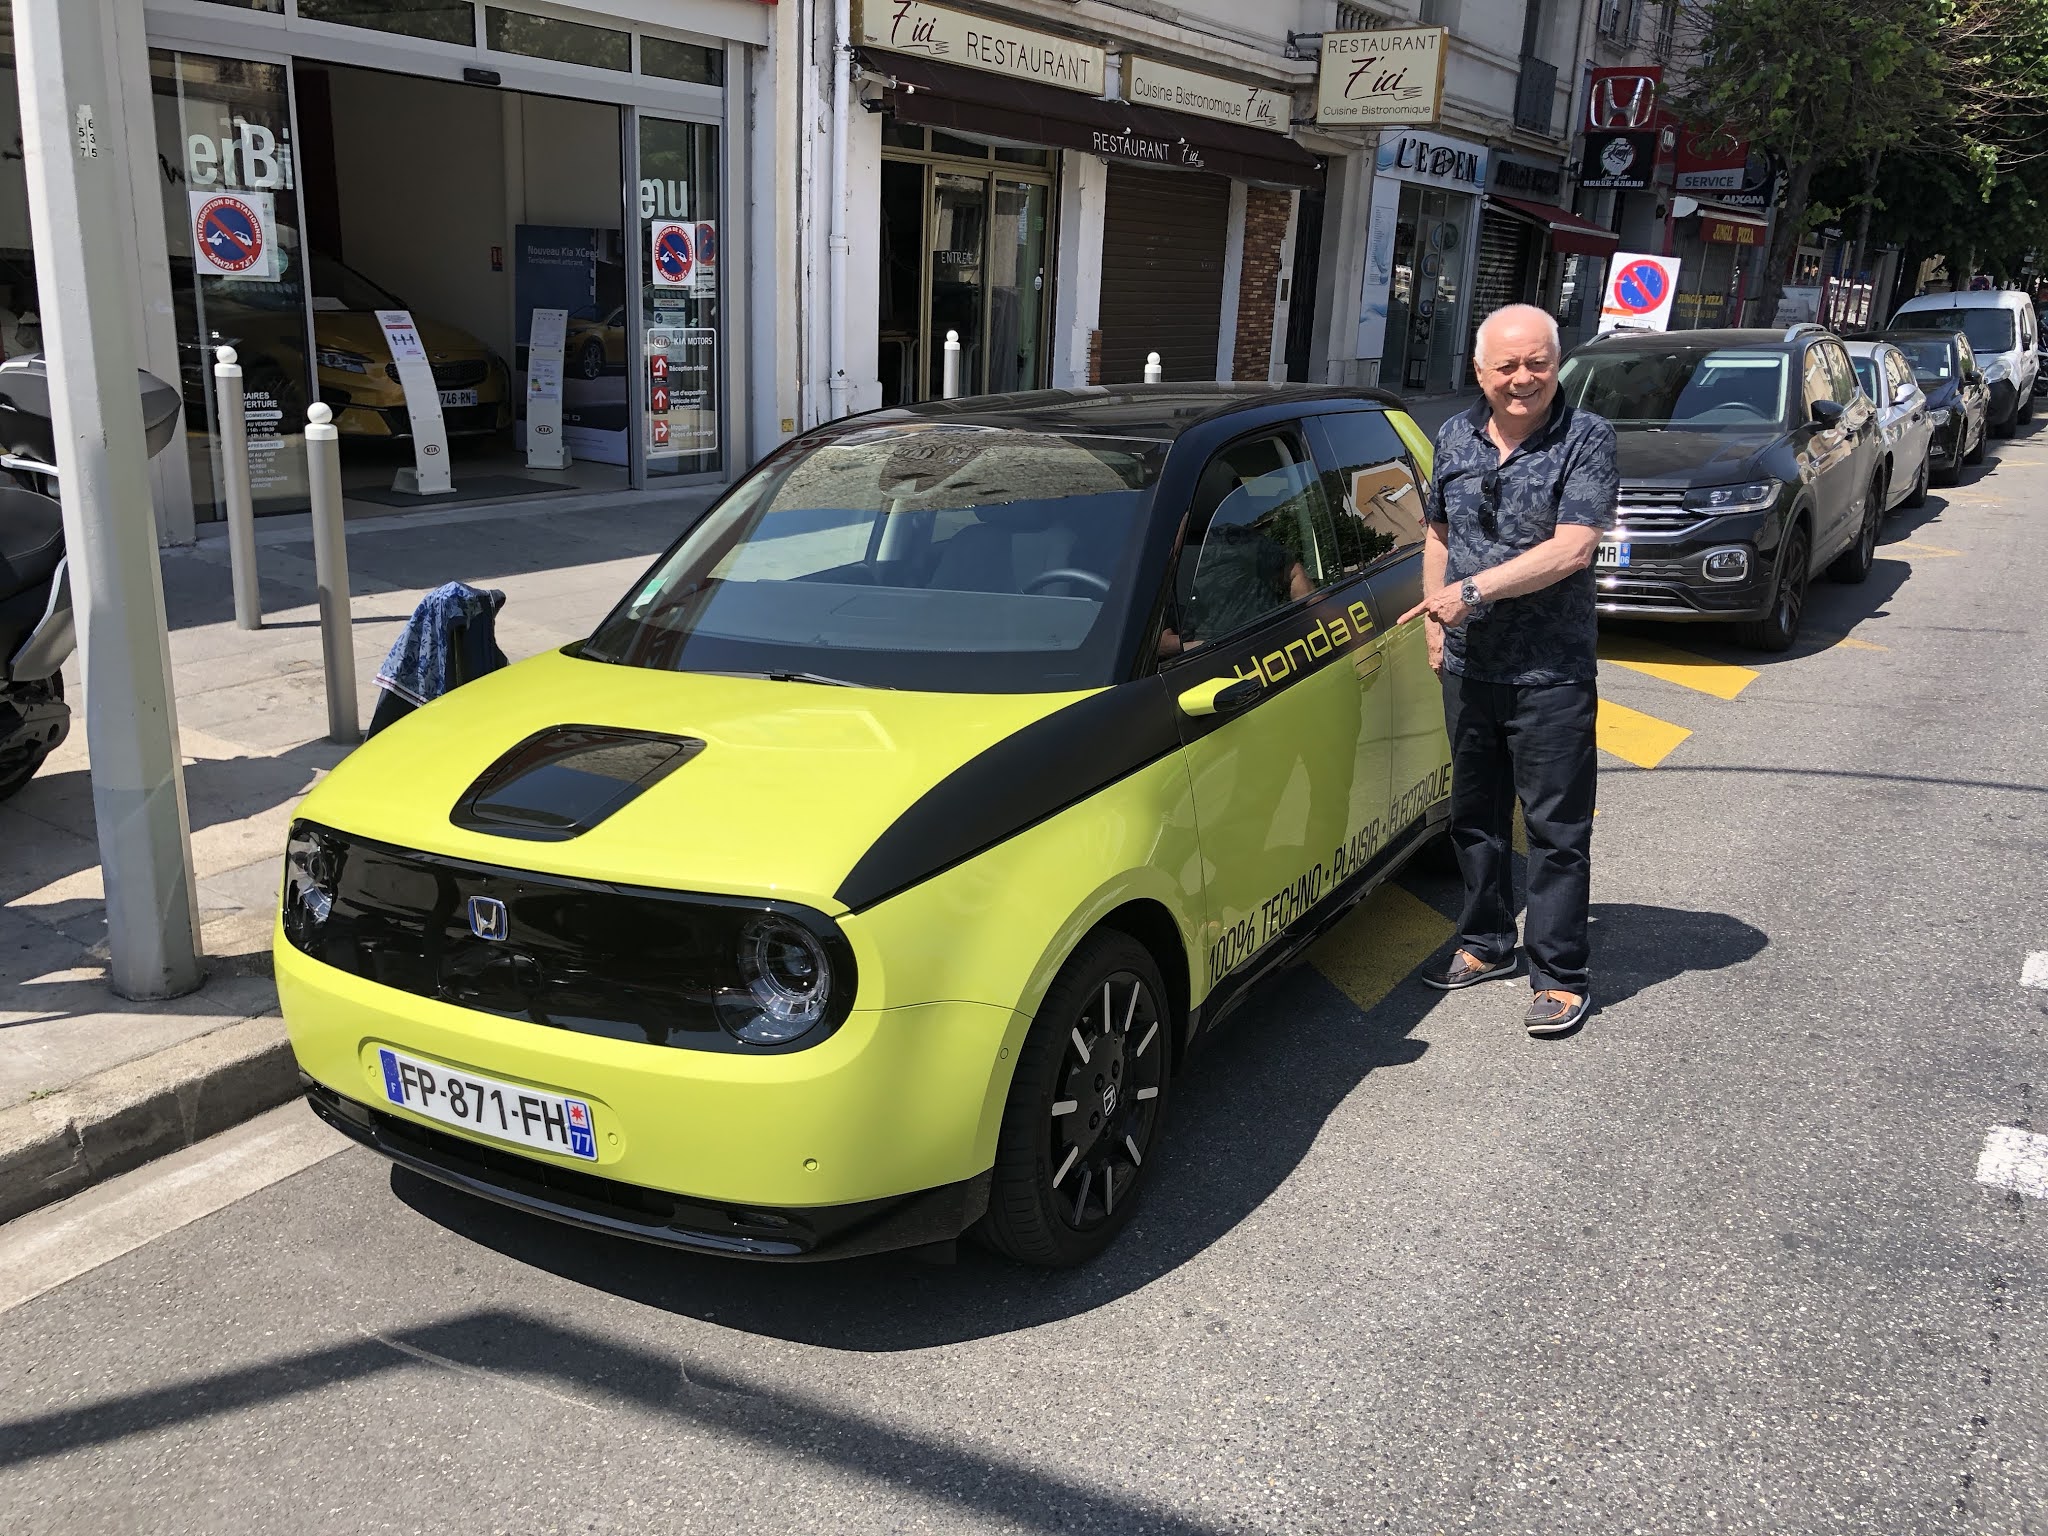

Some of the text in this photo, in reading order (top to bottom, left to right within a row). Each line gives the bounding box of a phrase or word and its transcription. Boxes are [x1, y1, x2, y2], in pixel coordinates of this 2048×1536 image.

[1328, 35, 1438, 54] RESTAURANT
[967, 31, 1091, 84] RESTAURANT
[1134, 77, 1173, 102] Cuisine
[1176, 86, 1242, 117] Bistronomique
[1323, 104, 1431, 116] Cuisine Bistronomique
[1093, 131, 1170, 161] RESTAURANT
[1685, 175, 1734, 187] SERVICE
[1722, 194, 1766, 205] AIXAM
[197, 199, 224, 242] INTERDICTION
[235, 201, 262, 245] STATIONNER
[1736, 226, 1755, 244] PIZZA
[527, 245, 560, 256] Nouveau
[561, 247, 574, 257] Kia
[674, 337, 687, 345] KIA
[687, 337, 713, 346] MOTORS
[669, 365, 693, 373] Réception
[440, 392, 472, 405] 746-RN
[1620, 555, 1630, 565] 06
[1233, 600, 1374, 688] Honda e
[1209, 762, 1452, 990] 100% TECHNO PLAISIR ÉLECTRIQUE
[390, 1061, 591, 1153] F FP-871-FH 77
